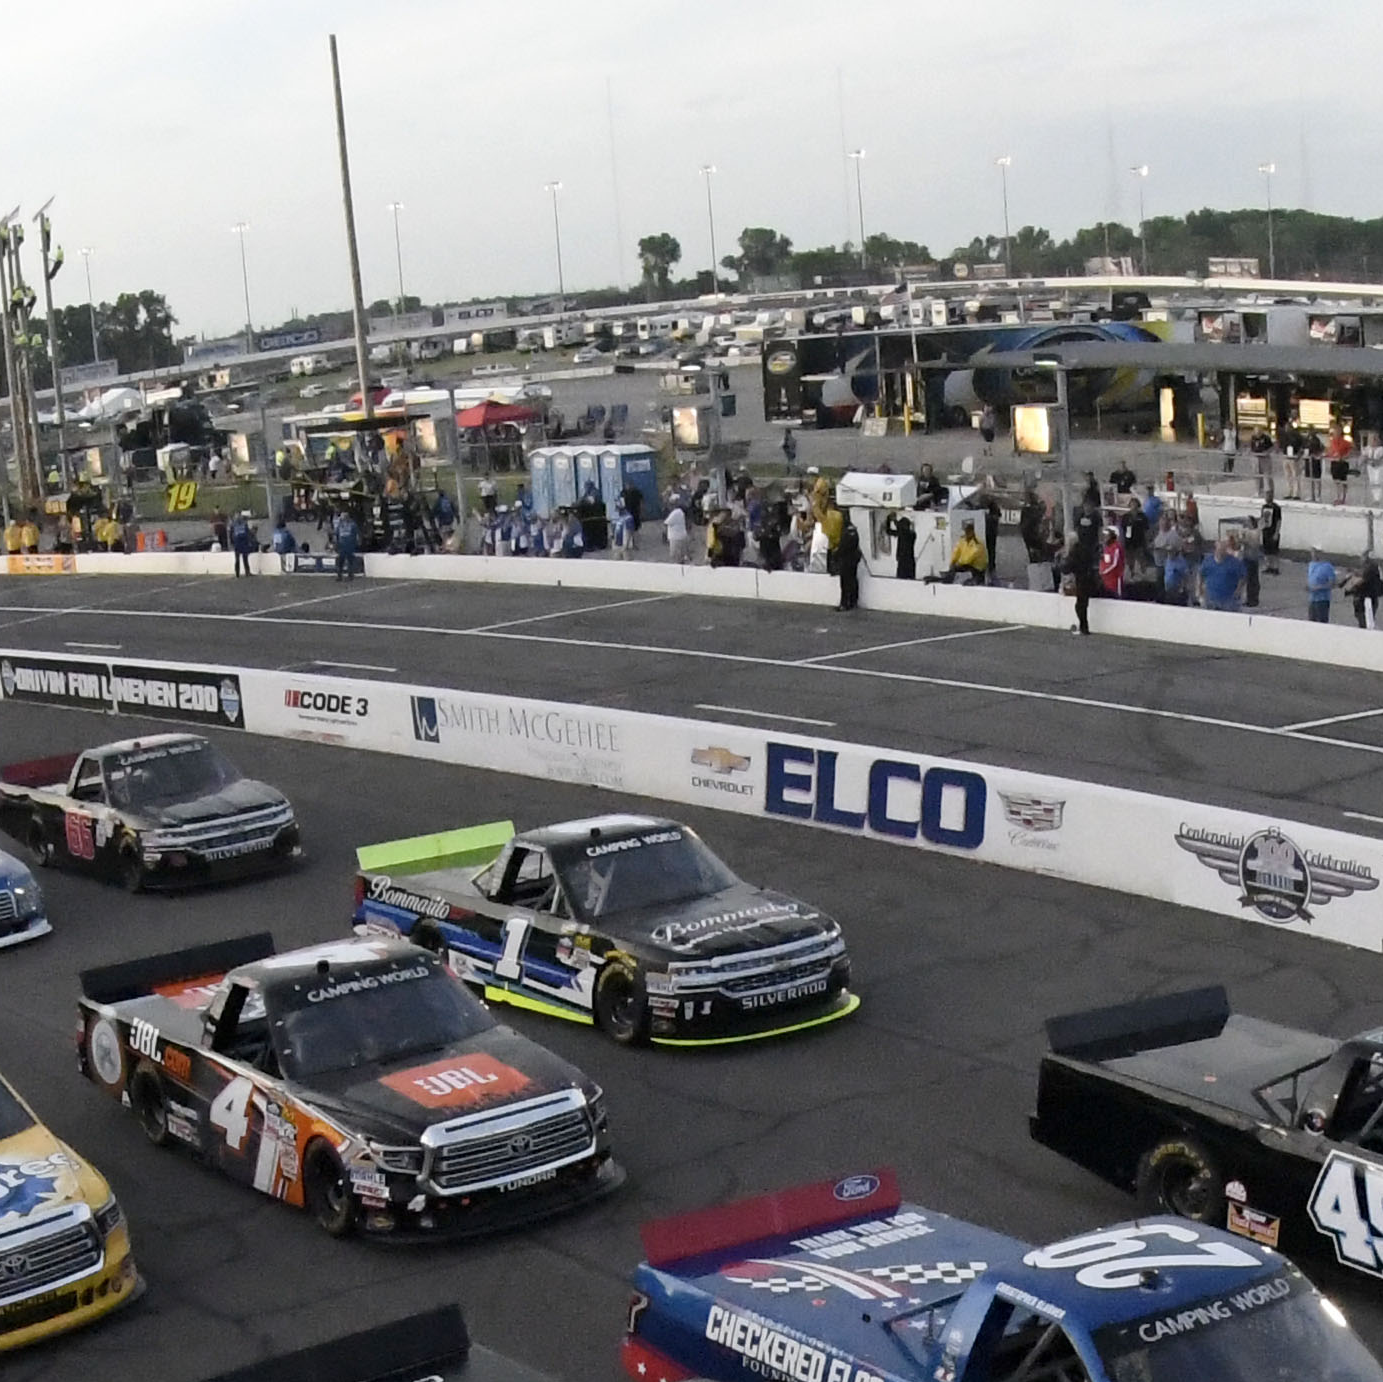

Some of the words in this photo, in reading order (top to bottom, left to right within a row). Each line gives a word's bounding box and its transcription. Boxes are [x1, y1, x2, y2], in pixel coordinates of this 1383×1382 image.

[168, 482, 196, 512] 19
[69, 672, 99, 699] FOR
[101, 675, 176, 708] LNEMEN
[180, 684, 218, 712] 200
[300, 691, 352, 715] CODE
[356, 699, 368, 716] 3
[439, 700, 500, 735] SMITH
[692, 777, 754, 795] CHEVROLET
[764, 742, 986, 849] ELCO
[586, 838, 641, 857] CAMPING
[642, 831, 681, 848] WORLD
[1179, 822, 1246, 848] Centennial
[1304, 849, 1371, 877] Celebration
[367, 875, 451, 920] Bommarito
[495, 917, 529, 980] 1
[307, 978, 377, 1003] CAMPING
[378, 966, 429, 988] WORLD
[743, 980, 827, 1010] SILVERADO
[414, 1067, 498, 1096] JBL
[210, 1076, 253, 1150] 4
[498, 1169, 557, 1192] TUNDRA
[1138, 1301, 1231, 1343] CAMPING
[1231, 1278, 1290, 1316] WORLD
